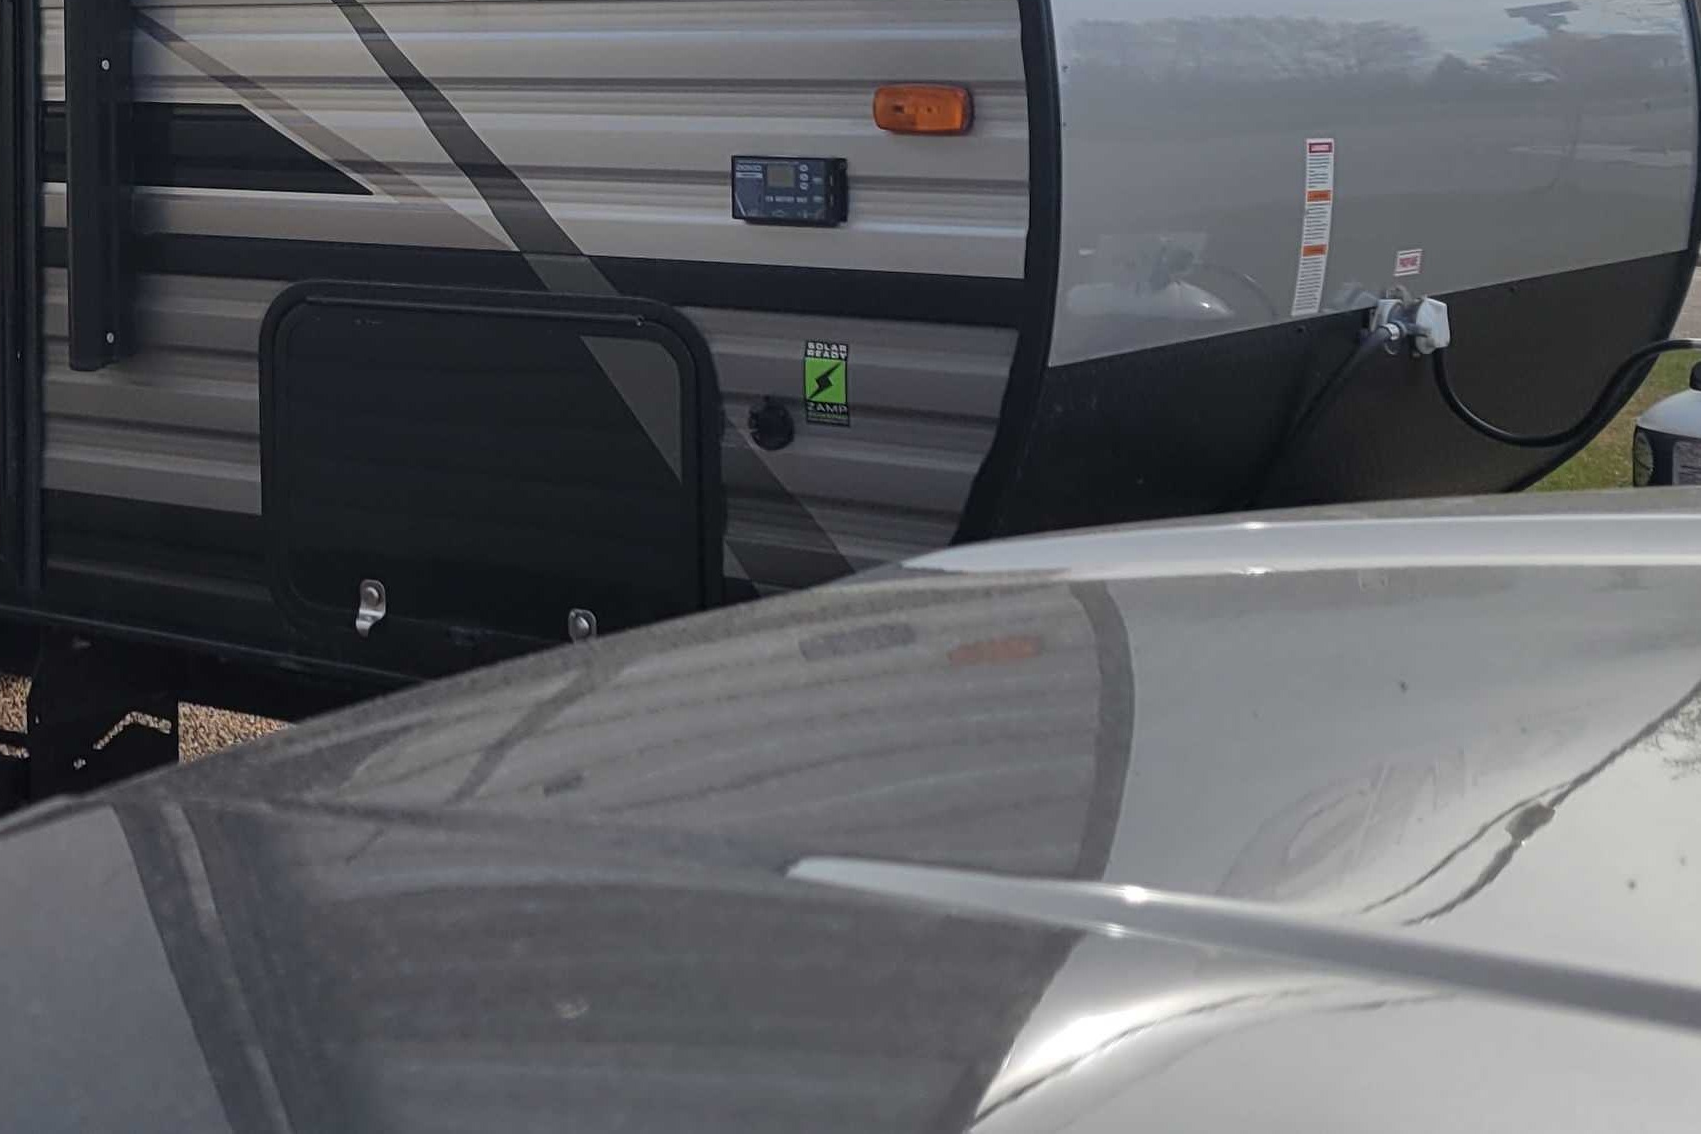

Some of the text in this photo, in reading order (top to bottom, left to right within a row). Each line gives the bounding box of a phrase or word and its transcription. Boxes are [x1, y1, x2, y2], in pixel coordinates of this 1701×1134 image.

[807, 342, 847, 352] SOLAR
[806, 349, 847, 360] READY
[807, 402, 848, 415] ZAMP
